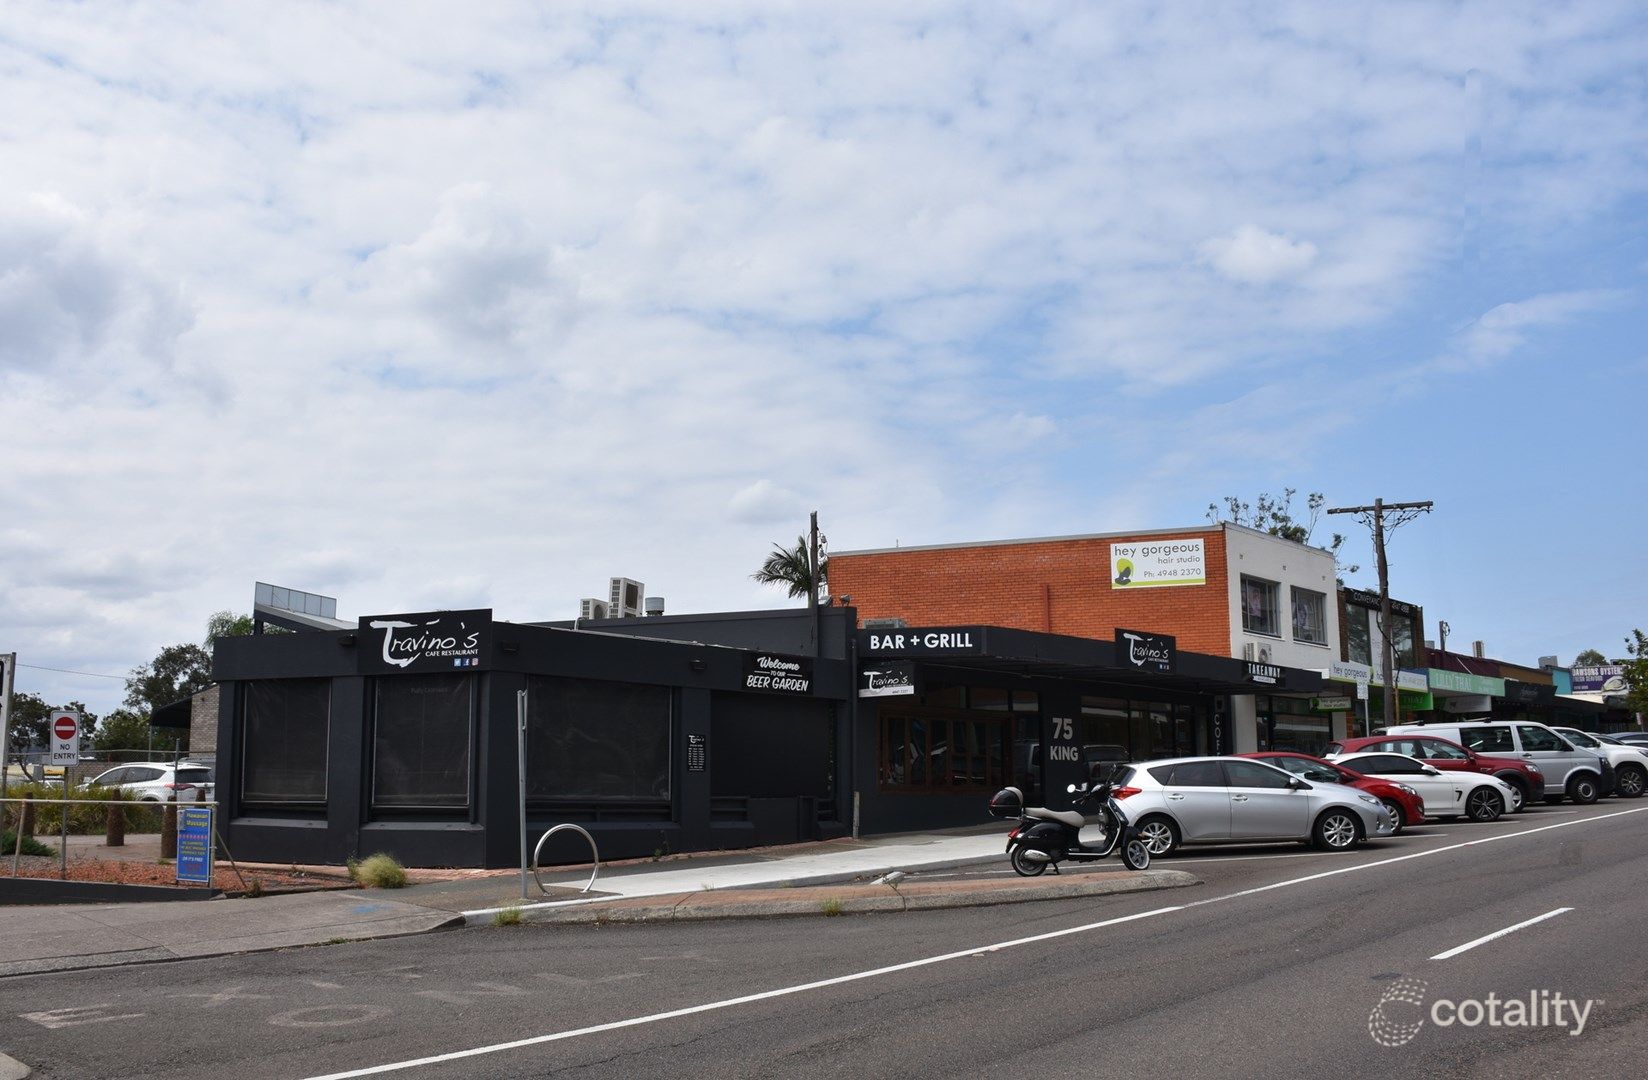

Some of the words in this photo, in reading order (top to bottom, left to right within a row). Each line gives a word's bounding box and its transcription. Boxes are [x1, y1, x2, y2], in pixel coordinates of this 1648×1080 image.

[1114, 545, 1137, 558] hey
[1141, 543, 1200, 557] gorgeous
[1176, 556, 1201, 564] studio
[1157, 569, 1178, 577] 4948
[1181, 568, 1202, 576] 2370
[870, 634, 905, 650] BAR
[910, 635, 920, 646] +
[924, 633, 973, 648] GRILL
[757, 656, 800, 671] Welcome
[1248, 663, 1281, 678] TAKEAWAY
[1333, 665, 1343, 675] hey
[1344, 667, 1368, 680] gorgeous
[1571, 667, 1599, 677] DAWSONS
[746, 675, 771, 689] BEER
[772, 677, 809, 692] GARDEN
[1052, 717, 1073, 740] 75
[1214, 713, 1222, 757] COF
[60, 743, 70, 751] NO
[1050, 745, 1079, 761] KING
[53, 752, 76, 760] ENTRY
